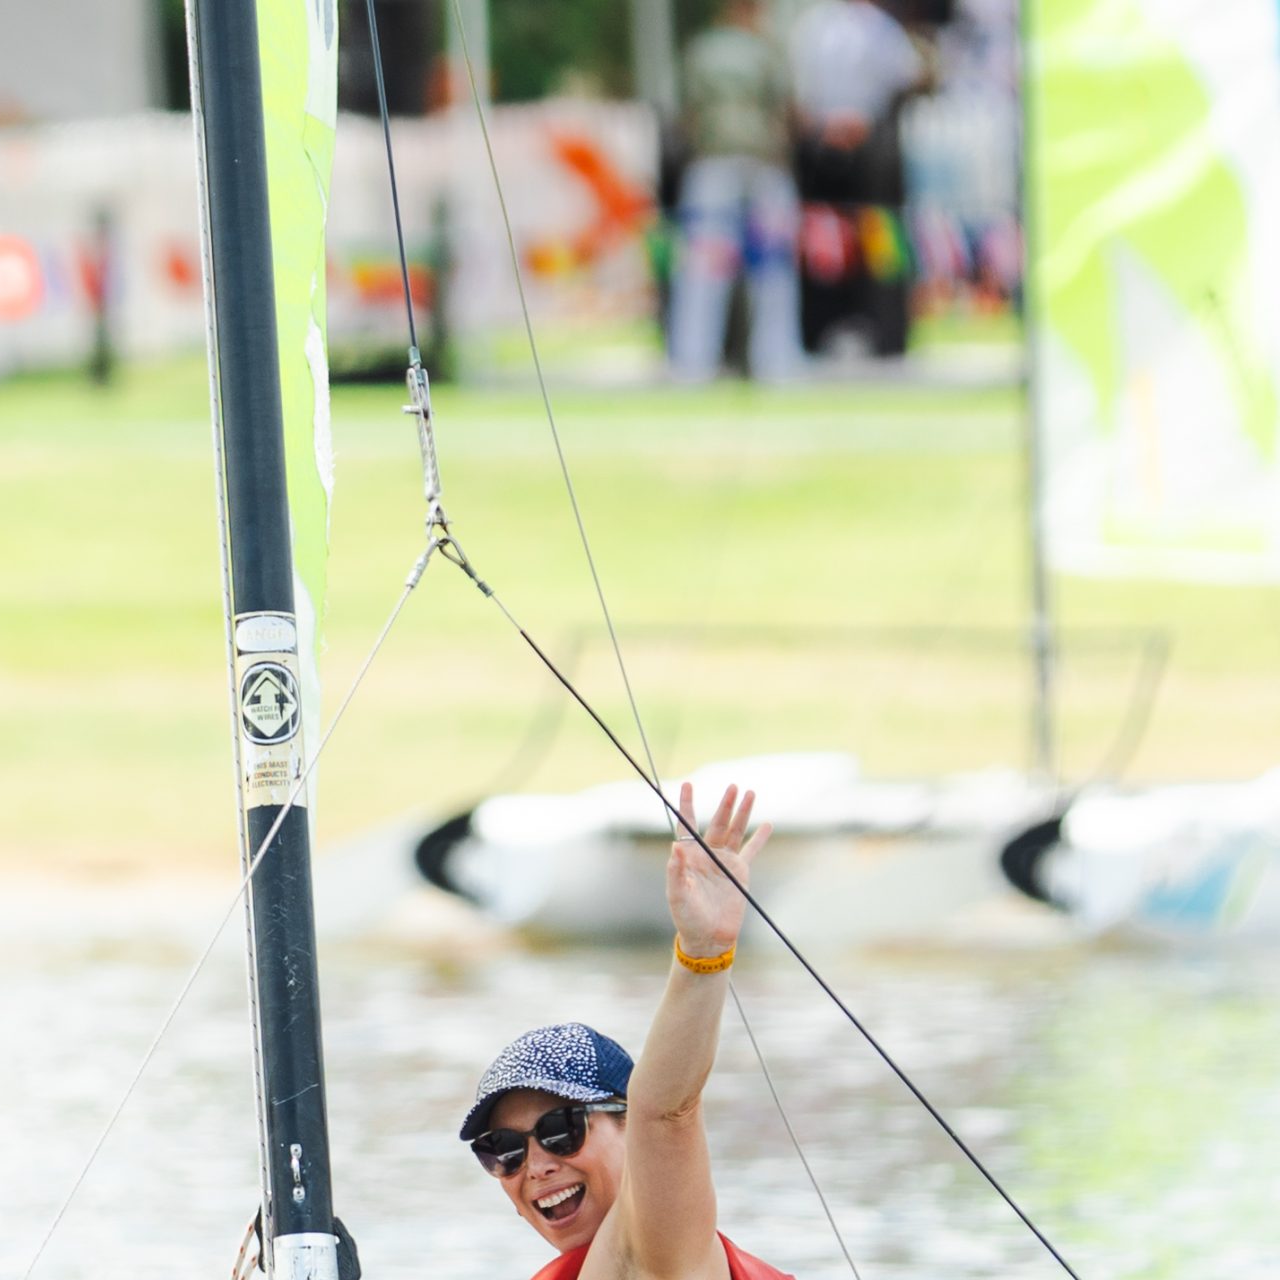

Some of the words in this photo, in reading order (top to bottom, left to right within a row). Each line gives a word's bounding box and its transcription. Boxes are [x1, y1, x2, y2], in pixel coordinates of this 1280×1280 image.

[251, 705, 273, 713] WATCH
[274, 704, 286, 712] FR
[257, 713, 280, 721] WIRES
[269, 760, 288, 769] MAST
[254, 770, 288, 779] CONDUCTS
